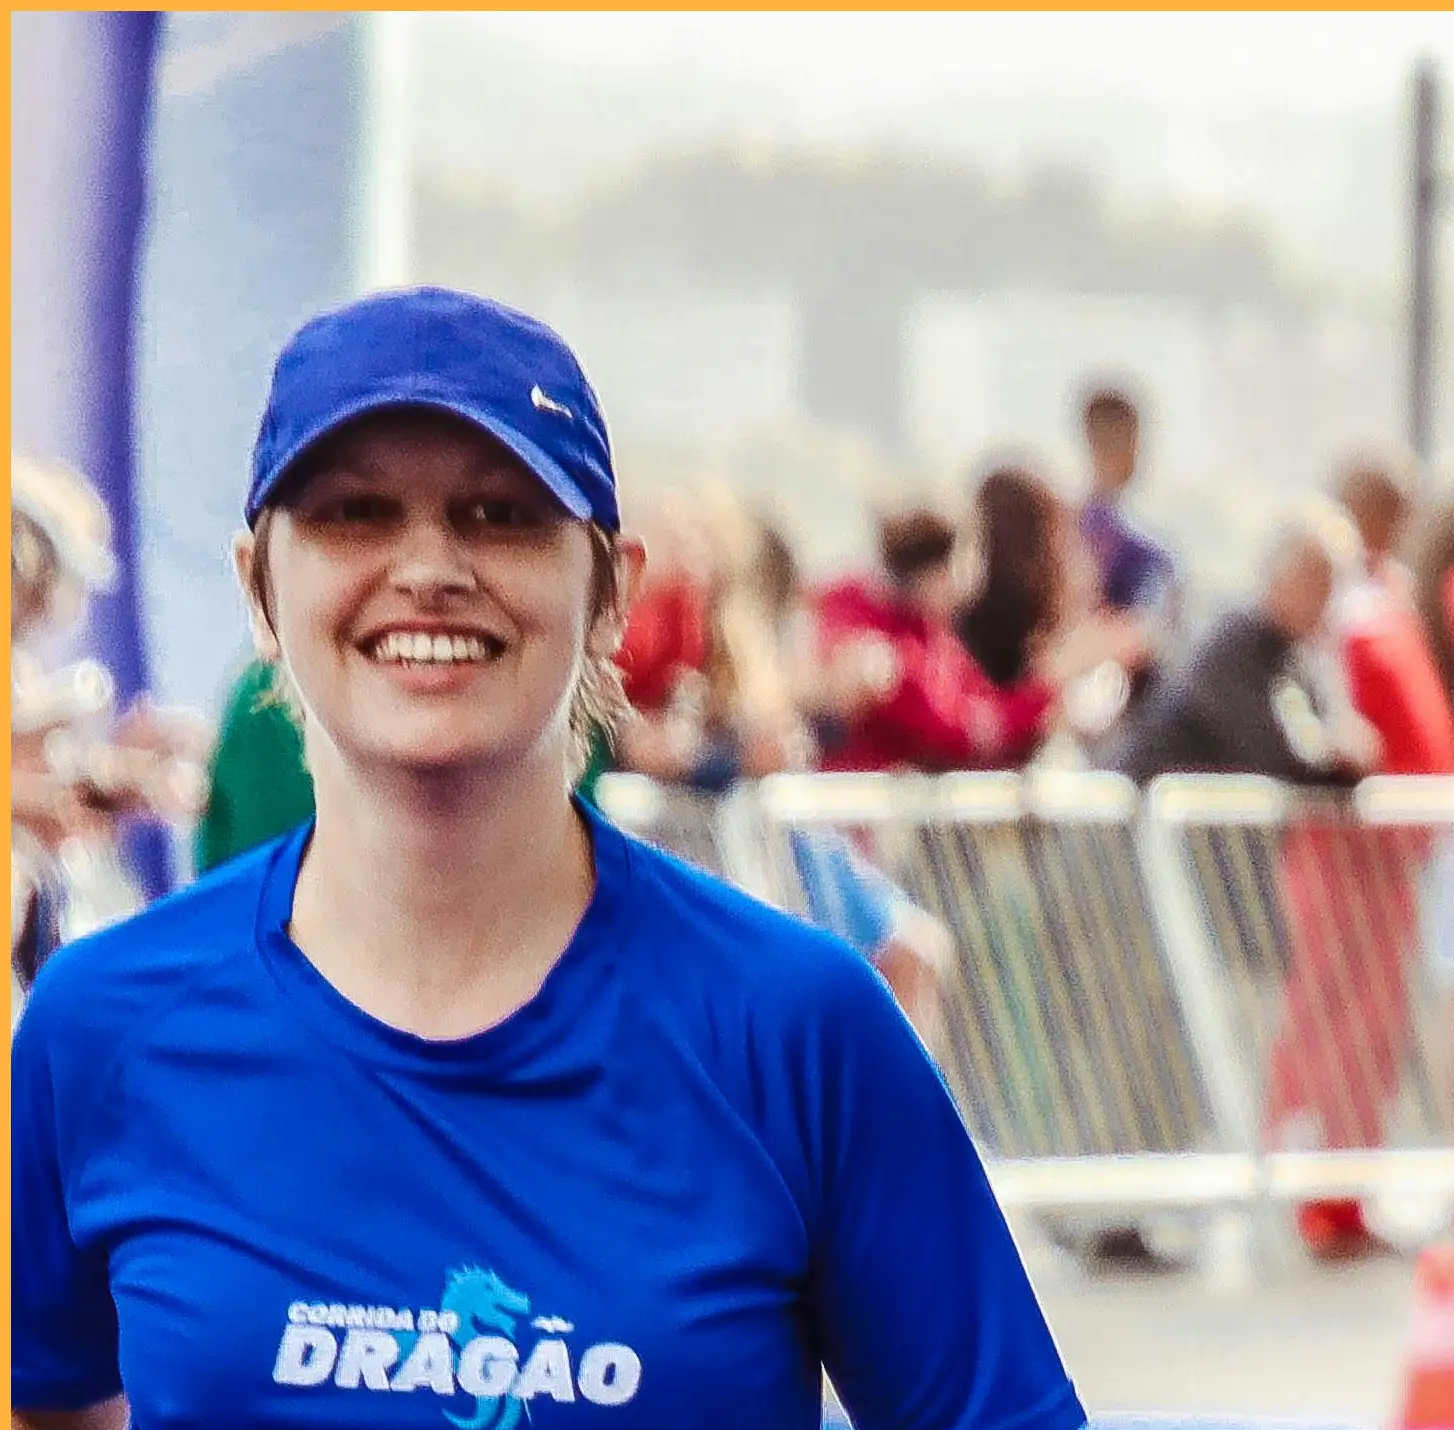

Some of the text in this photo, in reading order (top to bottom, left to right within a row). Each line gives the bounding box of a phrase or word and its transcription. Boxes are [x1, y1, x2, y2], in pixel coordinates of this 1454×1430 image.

[288, 1302, 459, 1334] CORRIDA DO
[273, 1315, 642, 1406] DRAGÃO
